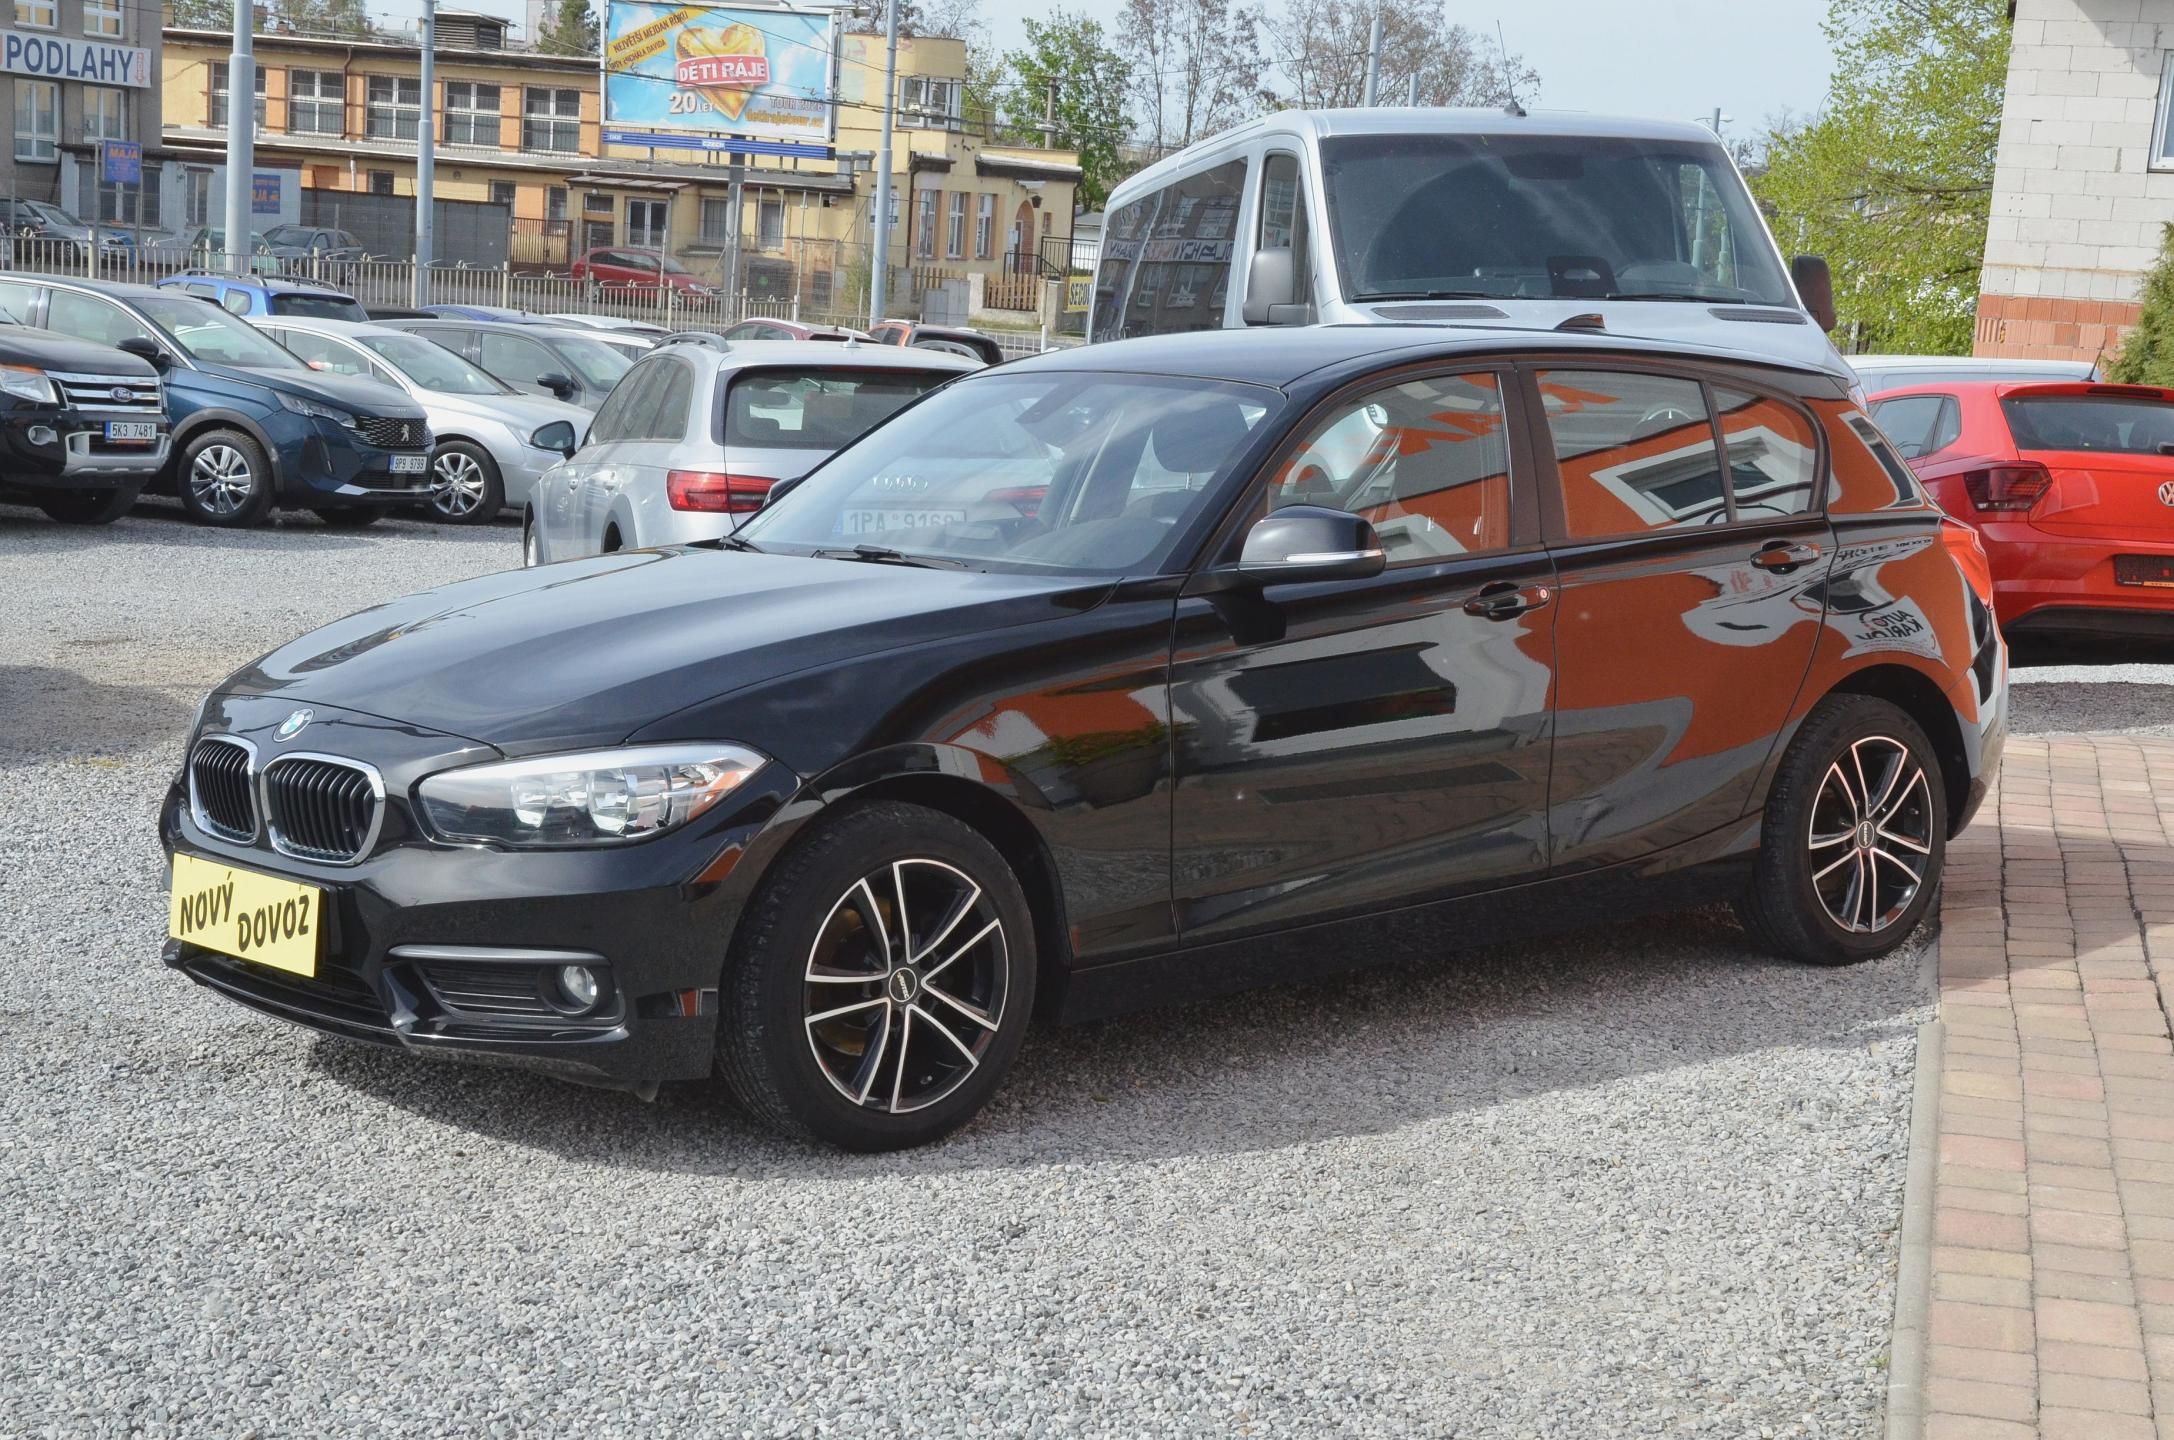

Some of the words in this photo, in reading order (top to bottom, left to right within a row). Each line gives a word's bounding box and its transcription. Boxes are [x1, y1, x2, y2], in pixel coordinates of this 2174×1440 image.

[643, 20, 669, 38] MEJDAN
[6, 35, 133, 82] PODLAHY
[679, 62, 718, 81] DĚTI
[721, 58, 766, 78] RÁJE
[669, 91, 698, 114] 20
[698, 103, 715, 113] LET
[112, 424, 128, 437] 5K3
[850, 512, 886, 533] 1PA
[180, 871, 234, 936] NOVÝ
[238, 894, 309, 952] DOVOZ
